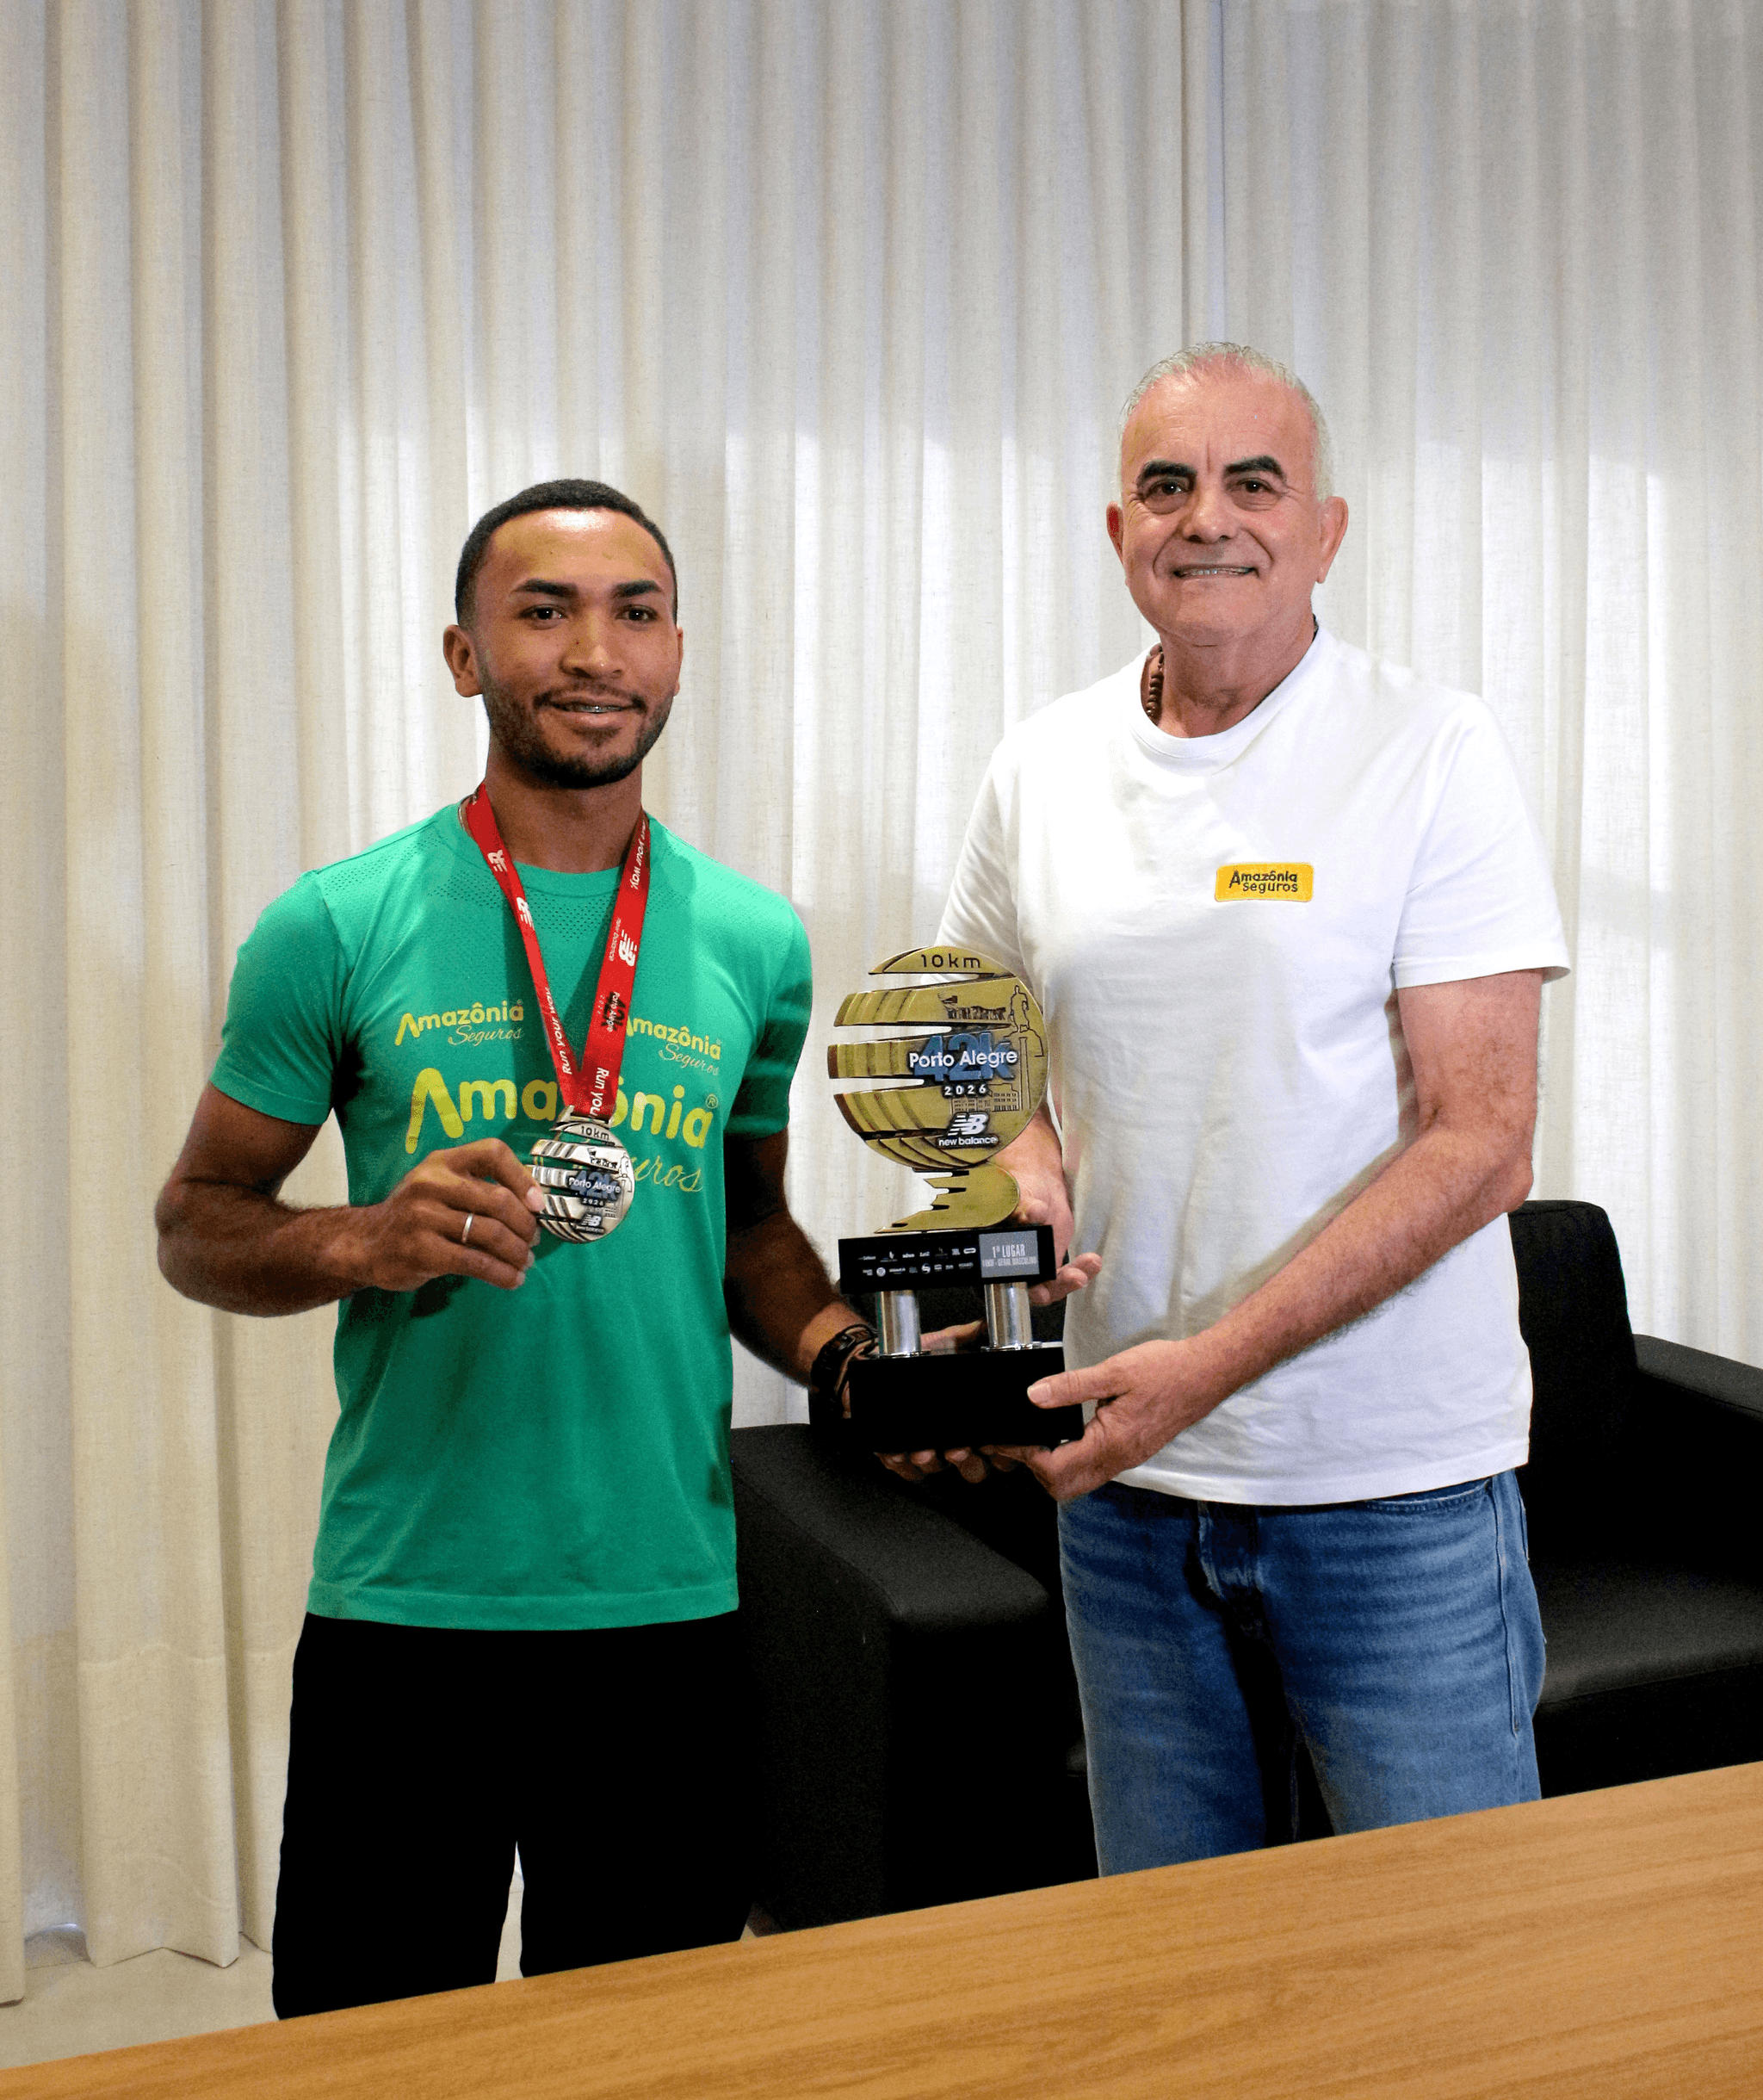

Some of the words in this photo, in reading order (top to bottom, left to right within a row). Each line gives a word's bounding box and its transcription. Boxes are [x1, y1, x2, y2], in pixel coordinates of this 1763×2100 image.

[636, 838, 645, 866] your
[1228, 870, 1297, 889] Amazônia
[609, 932, 619, 962] balance
[921, 953, 980, 968] 10km
[394, 1000, 524, 1046] Amazônia
[552, 1016, 566, 1047] your
[448, 1025, 523, 1047] Seguros
[560, 1050, 572, 1075] Run
[658, 1043, 720, 1075] Seguros
[909, 1051, 955, 1068] Porto
[959, 1050, 1018, 1068] Alegre
[594, 1067, 609, 1089] Run
[944, 1084, 987, 1096] 2026
[590, 1090, 603, 1117] you
[580, 1125, 609, 1141] 10km
[938, 1137, 957, 1146] new
[958, 1136, 999, 1146] balance
[568, 1177, 591, 1189] Porto
[593, 1180, 622, 1194] Alegre
[1002, 1243, 1026, 1257] LUGAR
